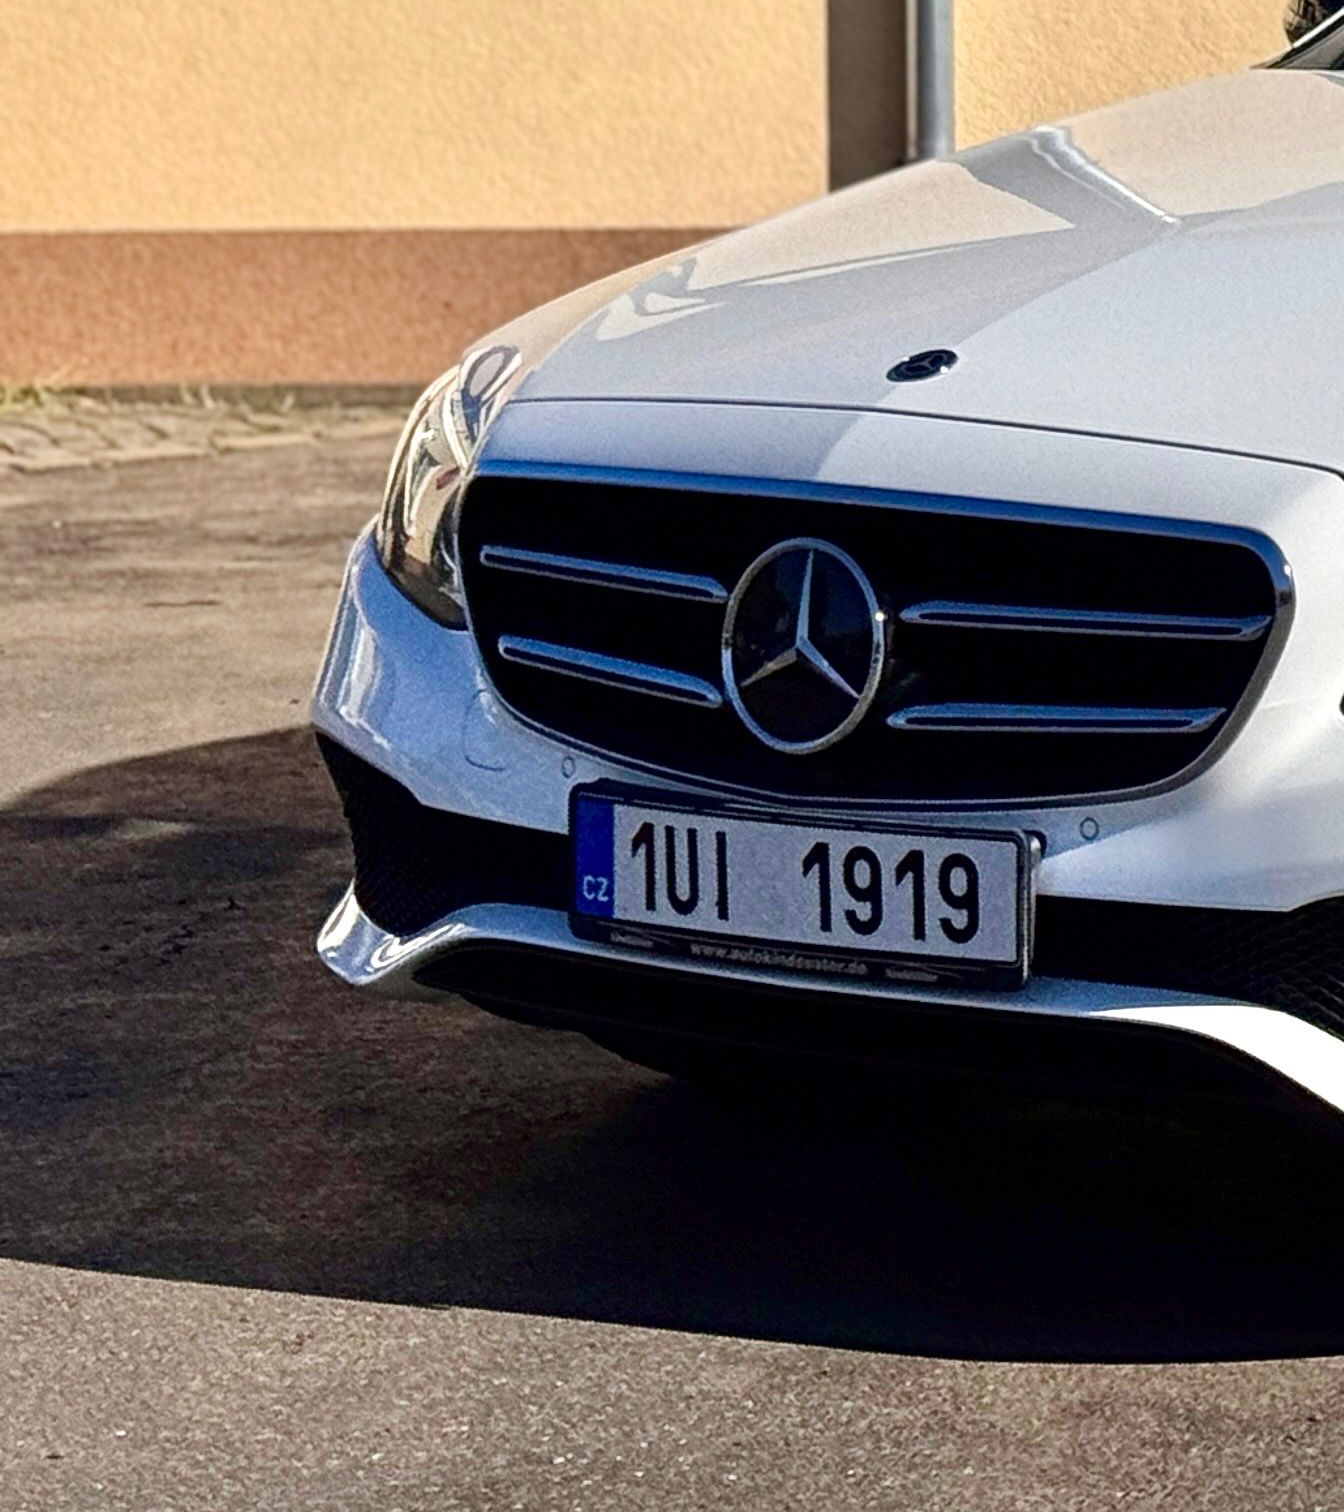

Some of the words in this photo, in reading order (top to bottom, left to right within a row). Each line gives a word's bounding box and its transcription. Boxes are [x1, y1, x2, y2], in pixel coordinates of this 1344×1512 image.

[582, 875, 609, 902] CZ
[631, 821, 729, 921] 1UI
[802, 841, 980, 944] 1919
